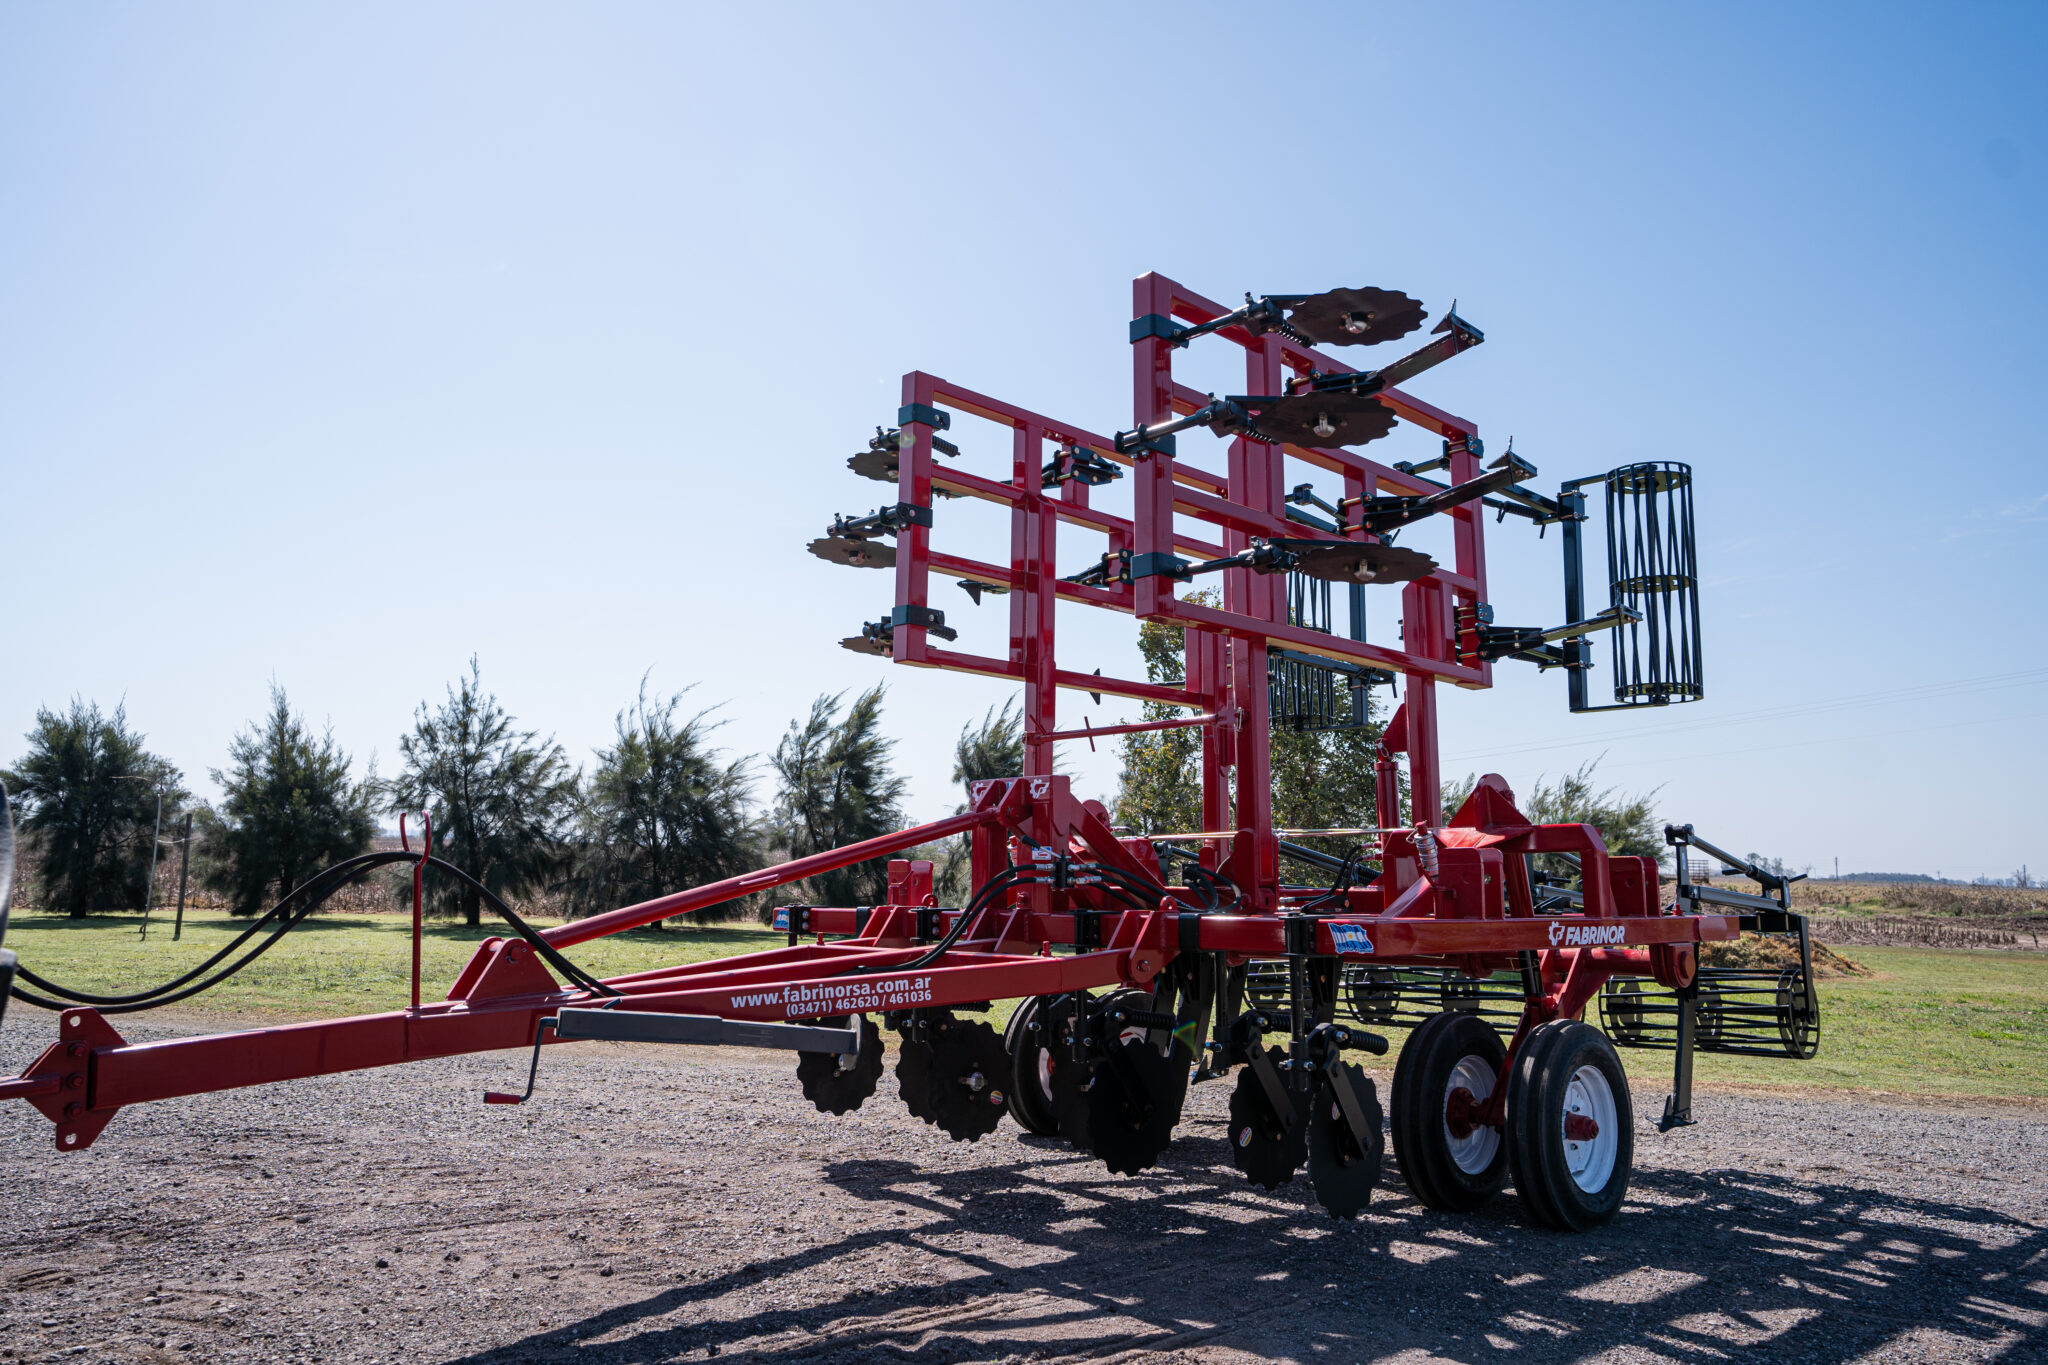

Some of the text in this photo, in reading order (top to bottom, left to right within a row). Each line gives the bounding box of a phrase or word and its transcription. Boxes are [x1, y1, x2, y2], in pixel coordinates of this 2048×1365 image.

[1565, 925, 1626, 946] FABRINOR
[731, 976, 932, 1008] www.fabrinorsa.com.ar
[786, 989, 932, 1017] (03471) 462620 / 461036
